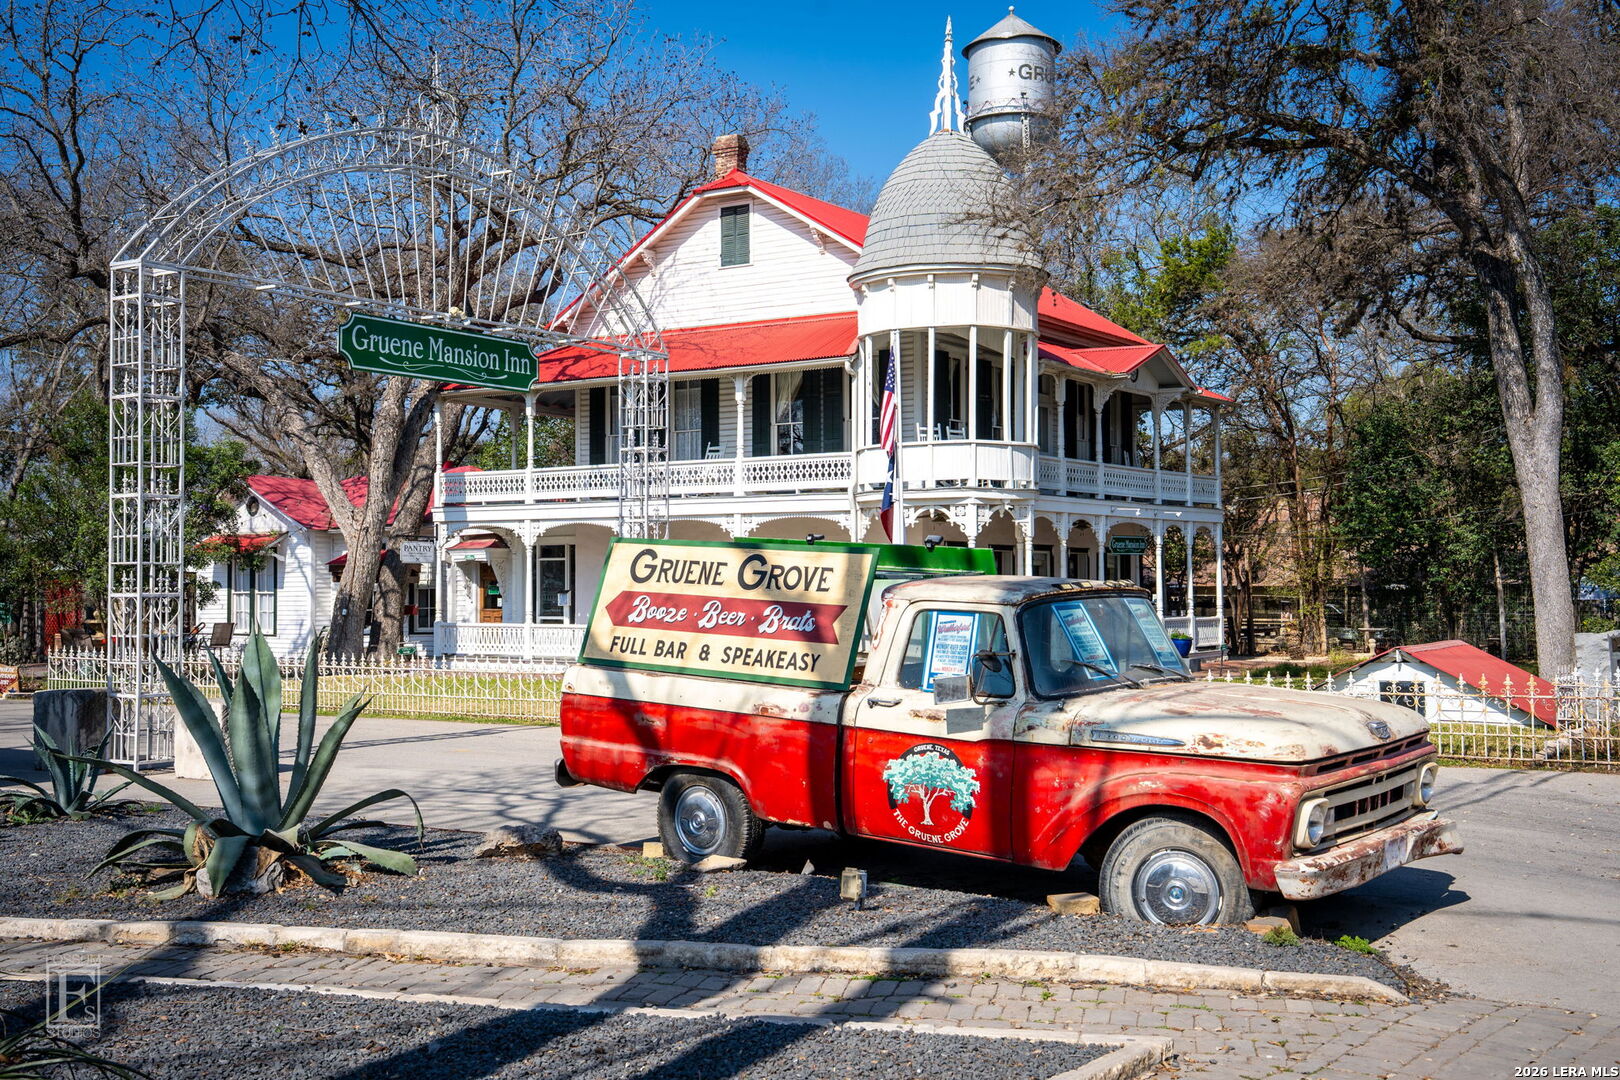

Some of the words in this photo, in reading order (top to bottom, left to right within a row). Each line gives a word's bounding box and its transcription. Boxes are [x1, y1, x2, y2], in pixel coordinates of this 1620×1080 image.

[351, 324, 424, 359] Gruene
[428, 336, 500, 371] Mansion
[504, 349, 531, 375] Inn
[403, 544, 432, 552] PANTRY
[629, 548, 728, 586] GRUENE
[737, 553, 834, 593] GROVE
[627, 595, 688, 624] Booze
[697, 600, 747, 629] Beer
[758, 605, 816, 634] Brats
[609, 635, 647, 656] FULL
[653, 639, 688, 660] BAR
[699, 644, 710, 662] &
[720, 646, 821, 673] SPEAKEASY
[935, 745, 951, 756] TEXAS
[893, 808, 908, 829] THE
[908, 825, 944, 844] GRUENE
[944, 817, 969, 842] GROVE
